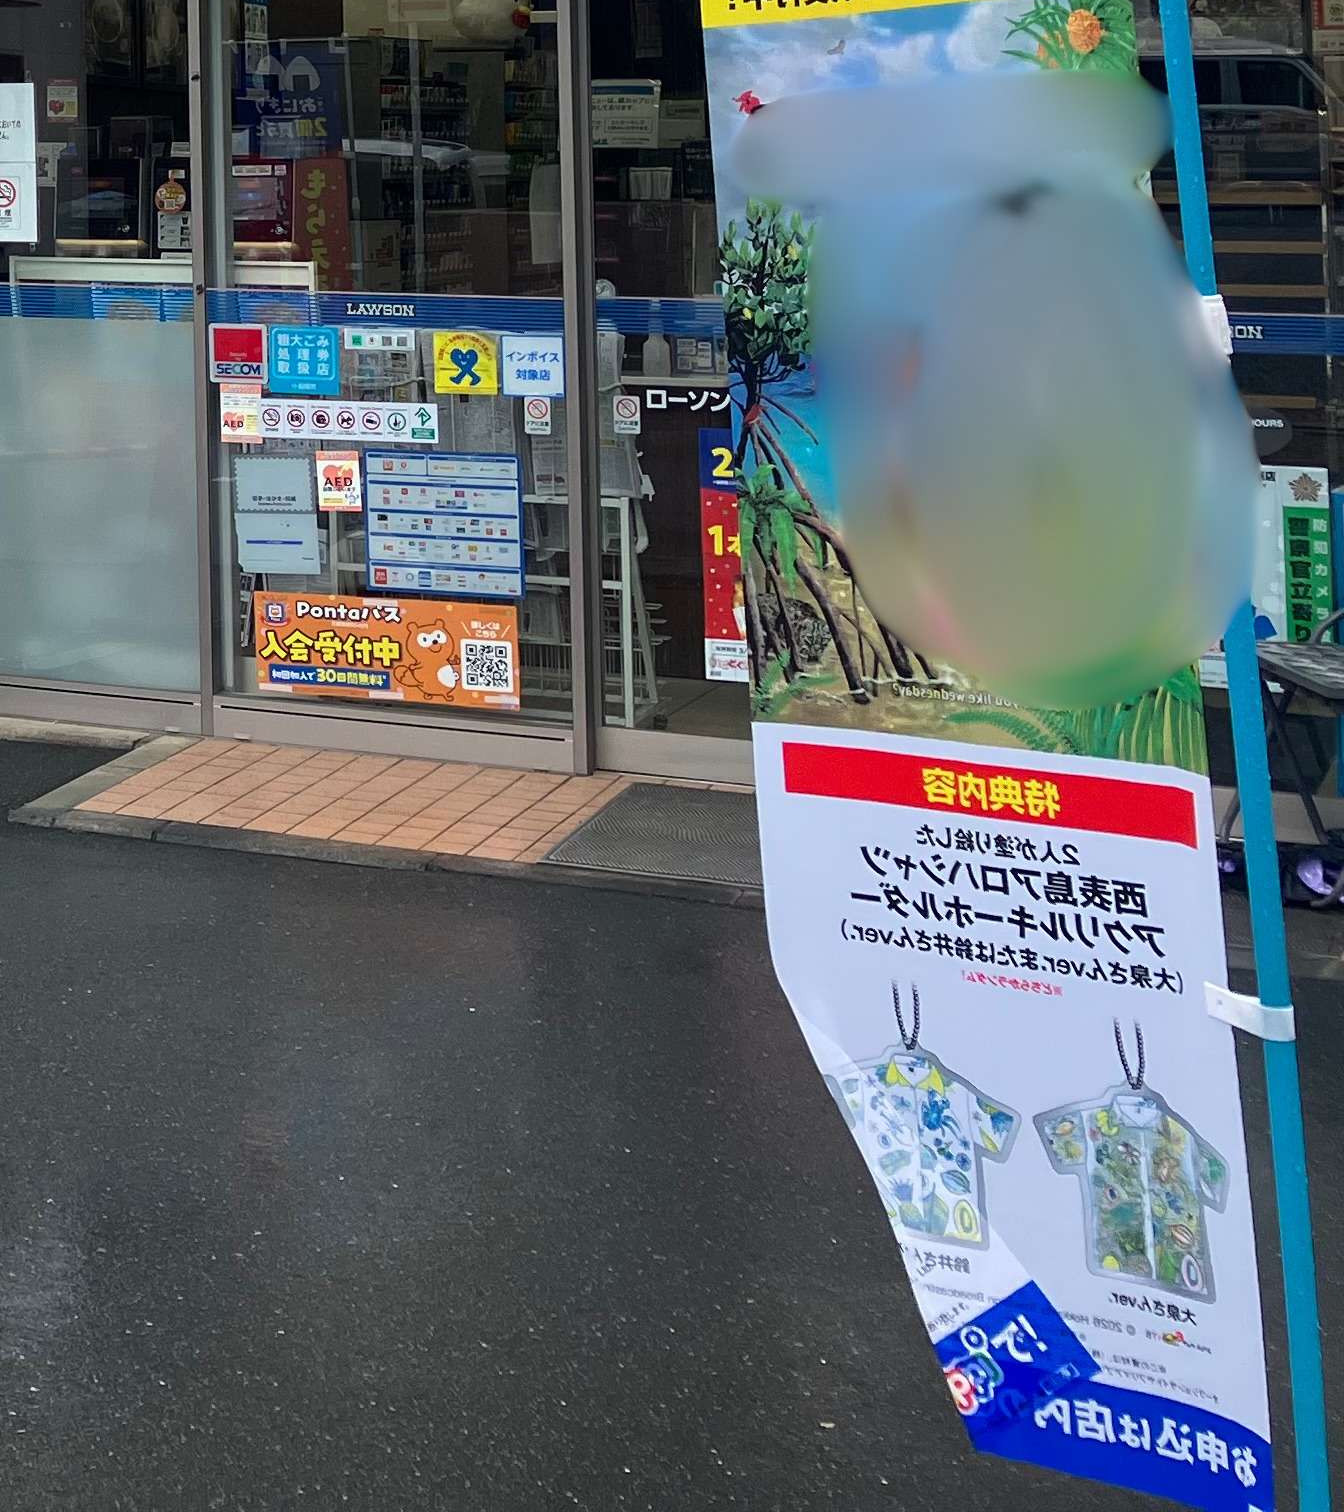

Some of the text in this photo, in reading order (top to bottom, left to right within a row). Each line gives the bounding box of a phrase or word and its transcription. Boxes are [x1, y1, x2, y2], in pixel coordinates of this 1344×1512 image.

[346, 302, 415, 317] LAWSON
[505, 351, 561, 364] インボイス
[216, 363, 261, 376] SECOM
[515, 369, 551, 382] 対象店
[646, 389, 731, 412] ローソン
[223, 420, 244, 429] AED
[1251, 418, 1284, 428] OURS
[324, 476, 353, 487] AED
[296, 600, 401, 623] Pontaパス
[261, 629, 401, 668] 入会受付中
